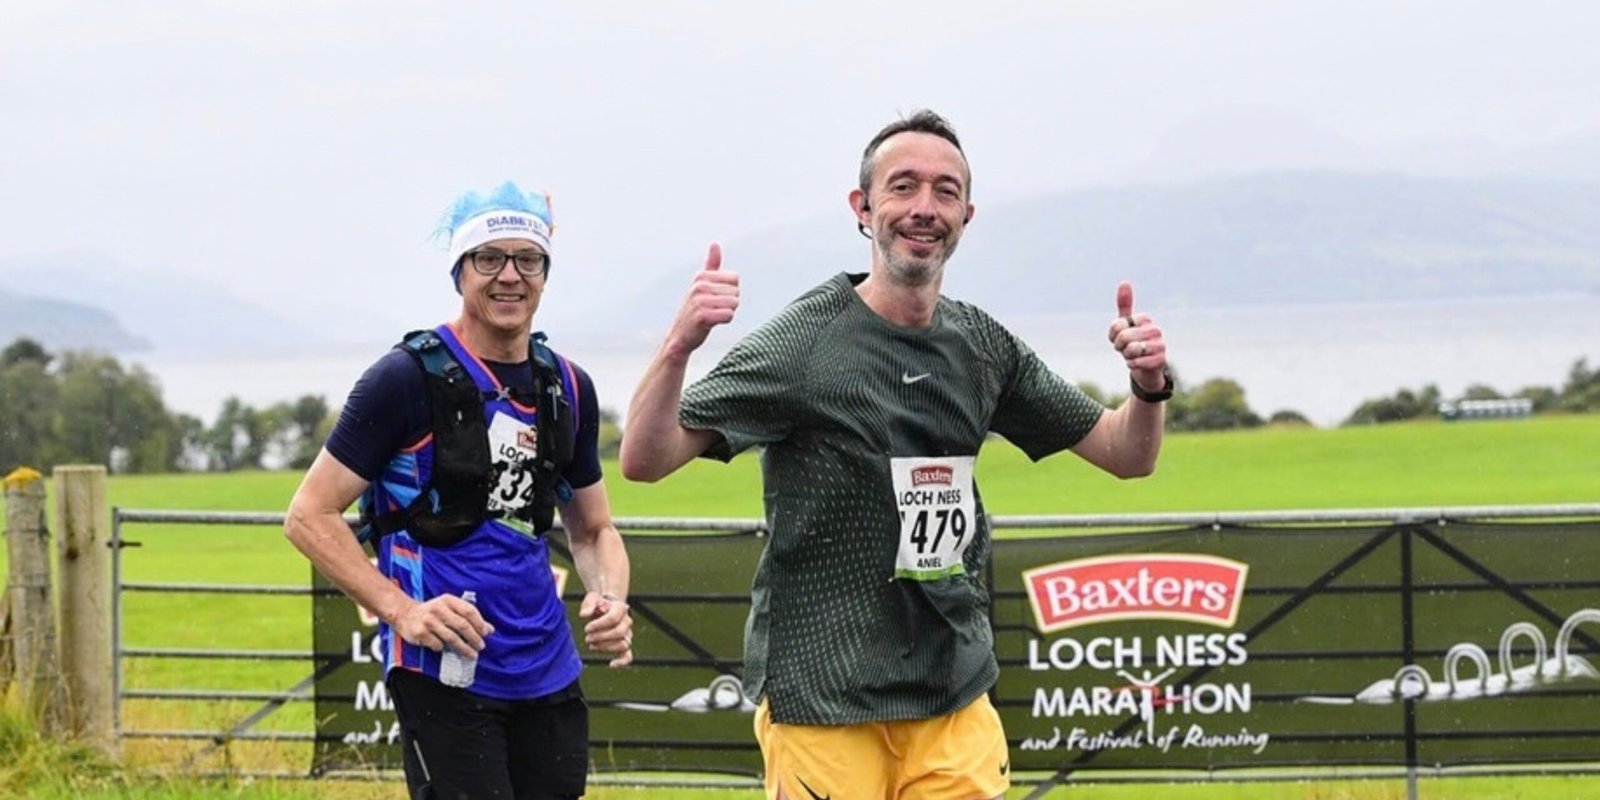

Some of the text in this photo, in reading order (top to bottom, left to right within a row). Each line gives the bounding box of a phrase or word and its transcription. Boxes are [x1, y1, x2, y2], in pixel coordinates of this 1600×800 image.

[899, 489, 961, 506] LOCH NESS
[1044, 568, 1228, 617] Baxters
[1029, 633, 1247, 670] LOCH NESS
[1032, 682, 1251, 718] MARATHON
[343, 721, 382, 743] and
[1020, 724, 1269, 754] and Festival of Running
